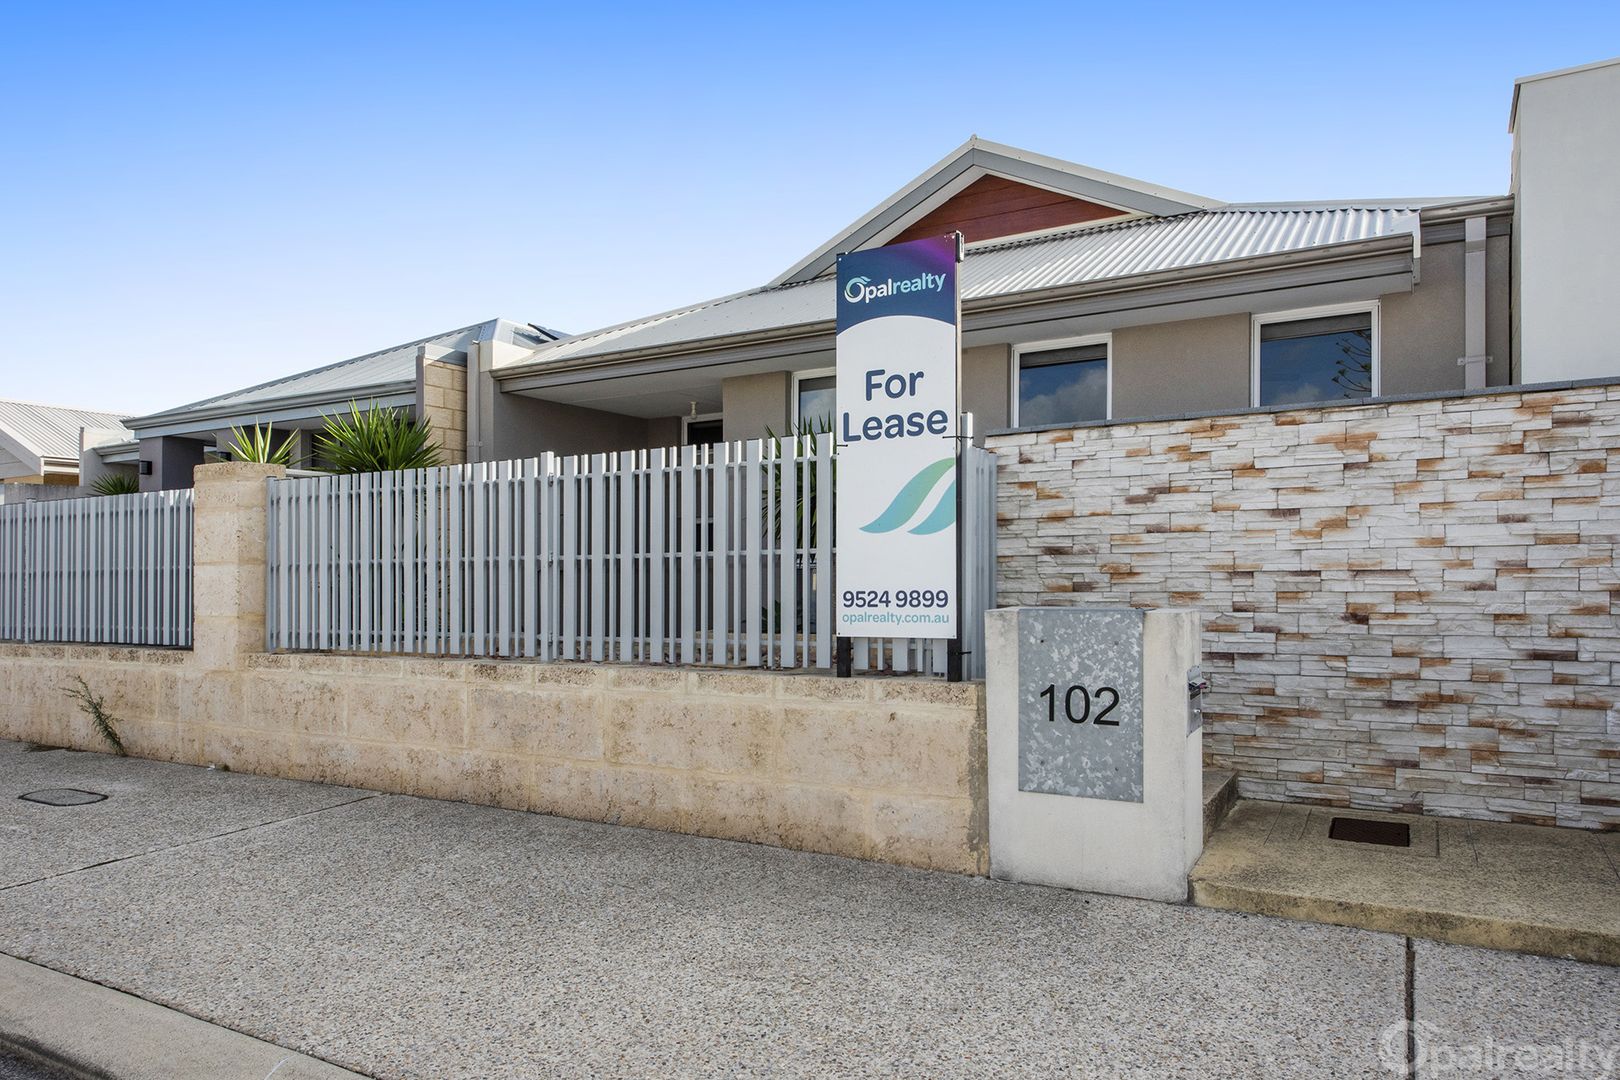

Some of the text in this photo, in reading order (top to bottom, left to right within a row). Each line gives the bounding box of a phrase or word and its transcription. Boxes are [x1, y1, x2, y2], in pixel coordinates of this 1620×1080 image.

[844, 272, 946, 303] Opalrealty
[865, 369, 924, 401] For
[843, 409, 948, 442] Lease
[843, 590, 949, 608] 9524 9899
[842, 612, 950, 625] opalrealty.com.au
[1040, 684, 1120, 726] 102
